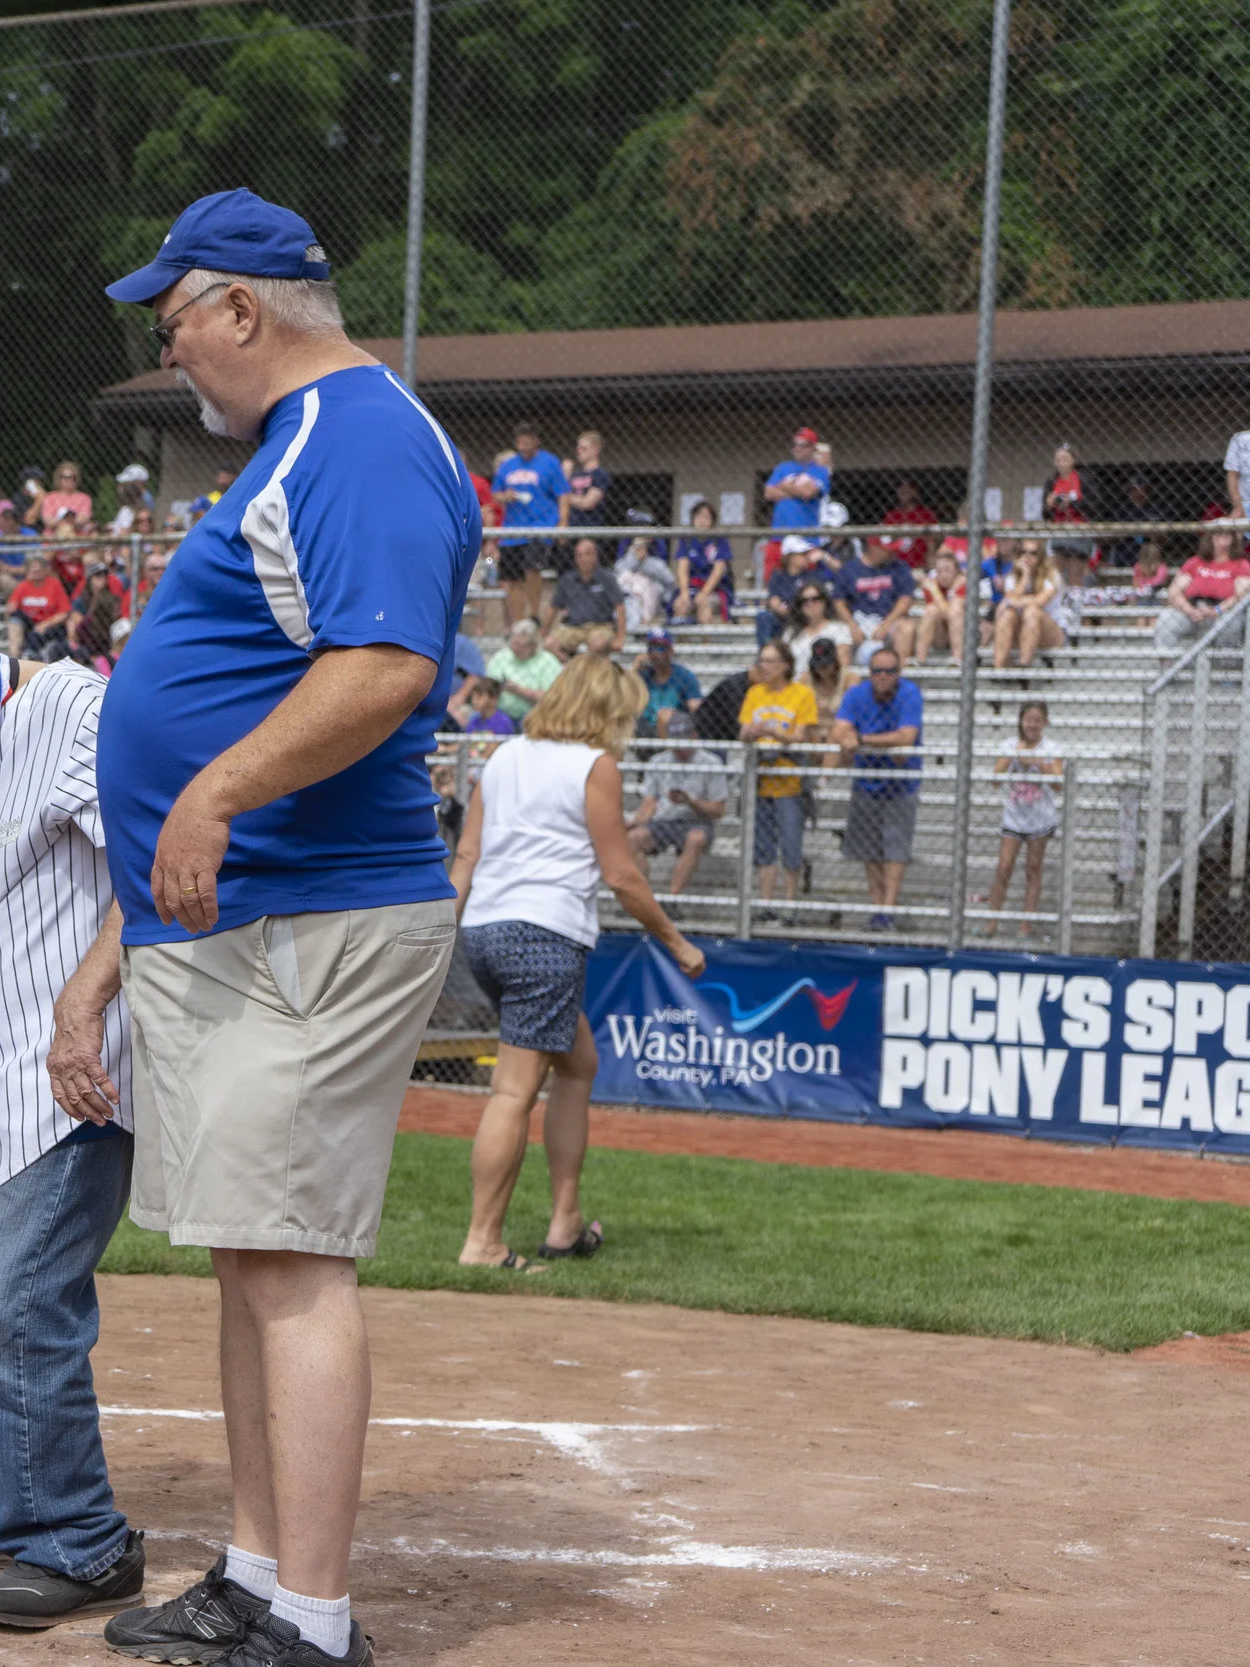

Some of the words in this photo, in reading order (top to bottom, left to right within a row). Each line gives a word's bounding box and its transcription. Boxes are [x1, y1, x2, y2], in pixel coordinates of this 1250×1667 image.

[653, 1004, 699, 1025] visit
[883, 966, 1113, 1050] DICK'S
[606, 1014, 842, 1082] Washington
[720, 1070, 752, 1088] PA
[879, 1038, 1069, 1121] PONY
[1079, 1051, 1250, 1135] LEAG
